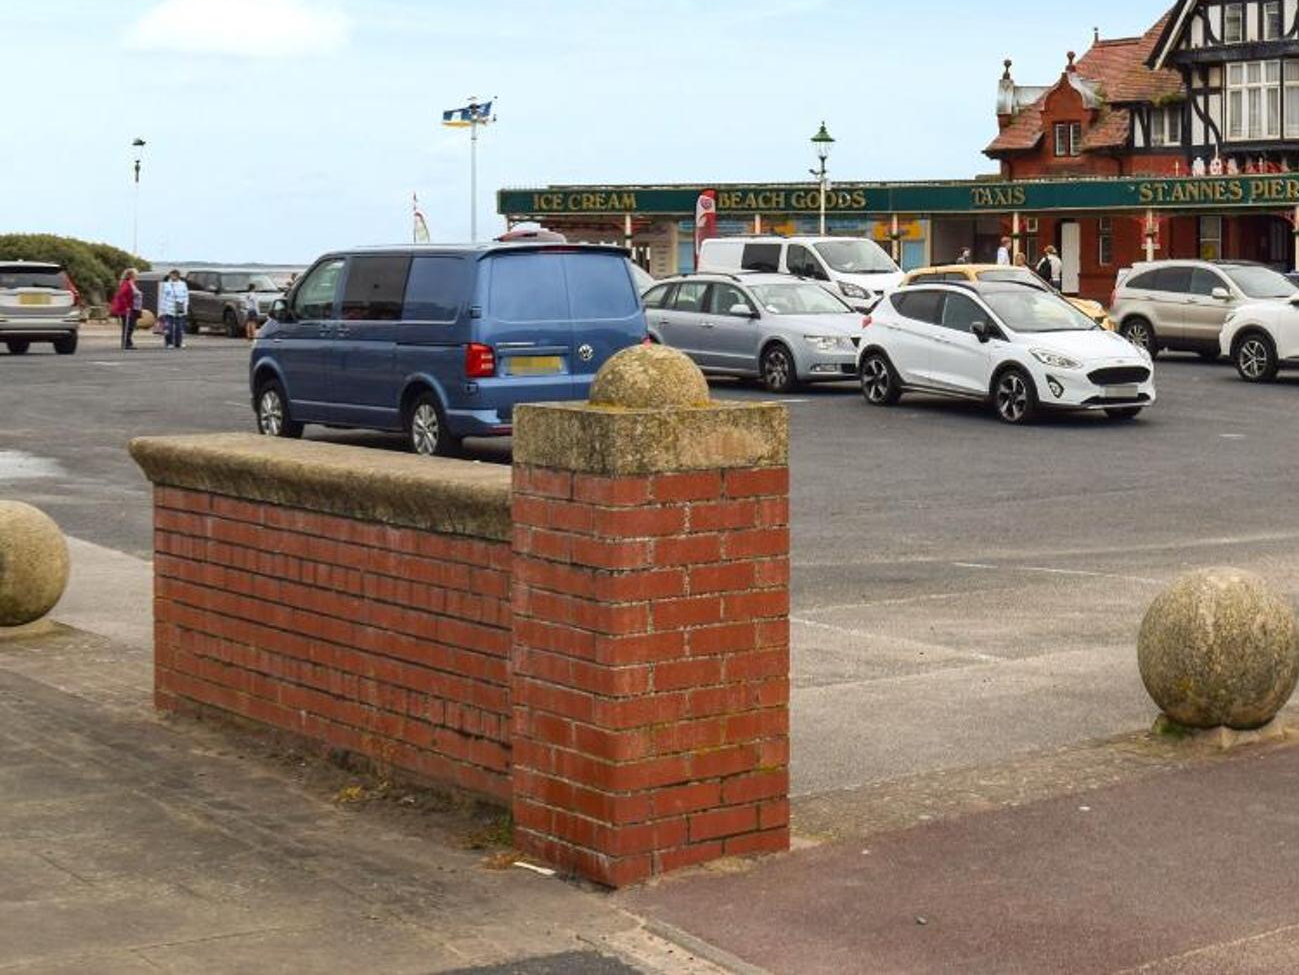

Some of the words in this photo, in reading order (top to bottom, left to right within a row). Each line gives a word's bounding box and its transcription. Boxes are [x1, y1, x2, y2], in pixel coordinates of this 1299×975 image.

[533, 193, 564, 210] ICE
[568, 192, 637, 210] CREAM
[717, 191, 786, 208] BEACH
[790, 190, 867, 209] GOODS
[970, 186, 1026, 205] TAXIS
